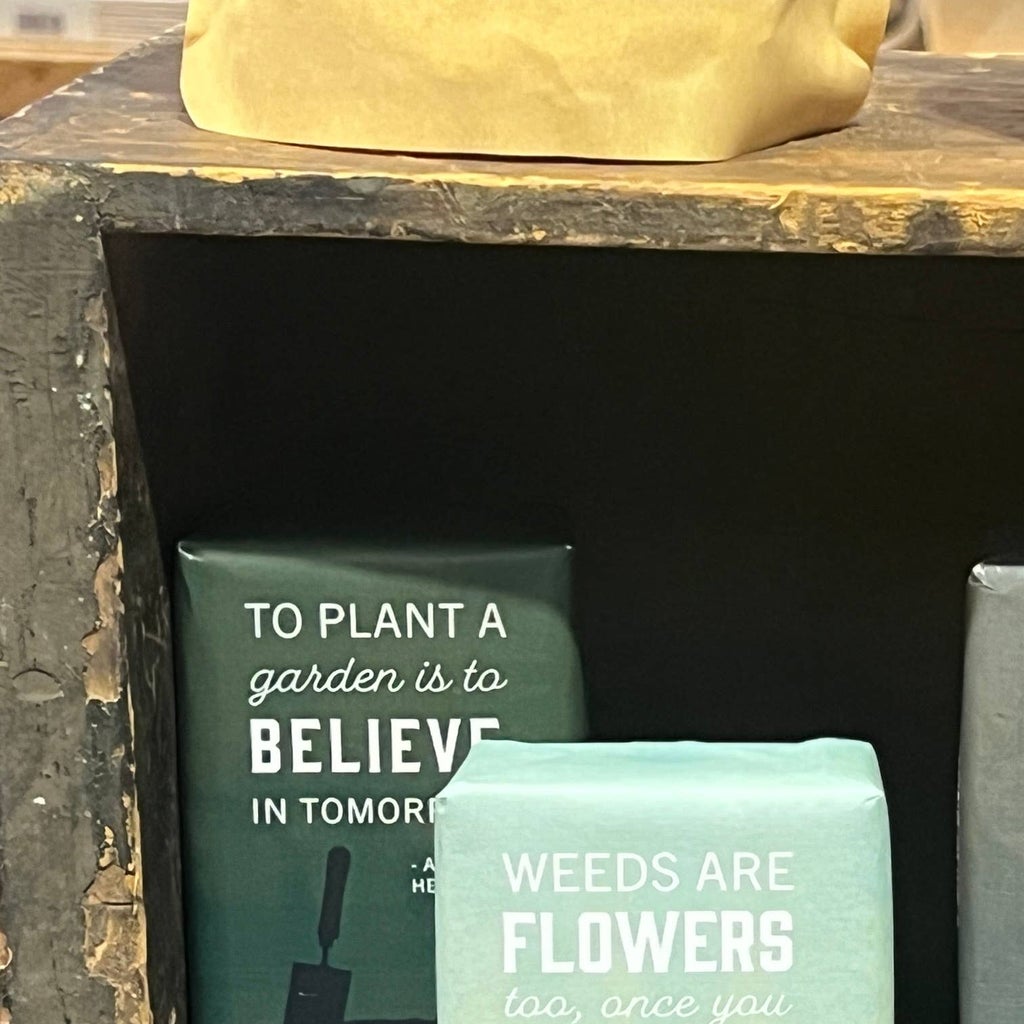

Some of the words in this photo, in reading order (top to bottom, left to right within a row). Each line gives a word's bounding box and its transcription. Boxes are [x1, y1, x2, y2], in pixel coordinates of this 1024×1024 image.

[243, 602, 303, 639] TO
[319, 602, 465, 639] PLANT
[478, 602, 507, 639] A
[248, 657, 406, 707] garden
[415, 661, 454, 693] is
[463, 659, 508, 693] to
[252, 797, 287, 825] IN
[298, 796, 435, 827] TOMOR
[502, 851, 680, 893] WEEDS
[696, 851, 795, 892] ARE
[502, 910, 793, 974] FLOWERS
[504, 987, 583, 1024] too,
[600, 995, 700, 1019] once
